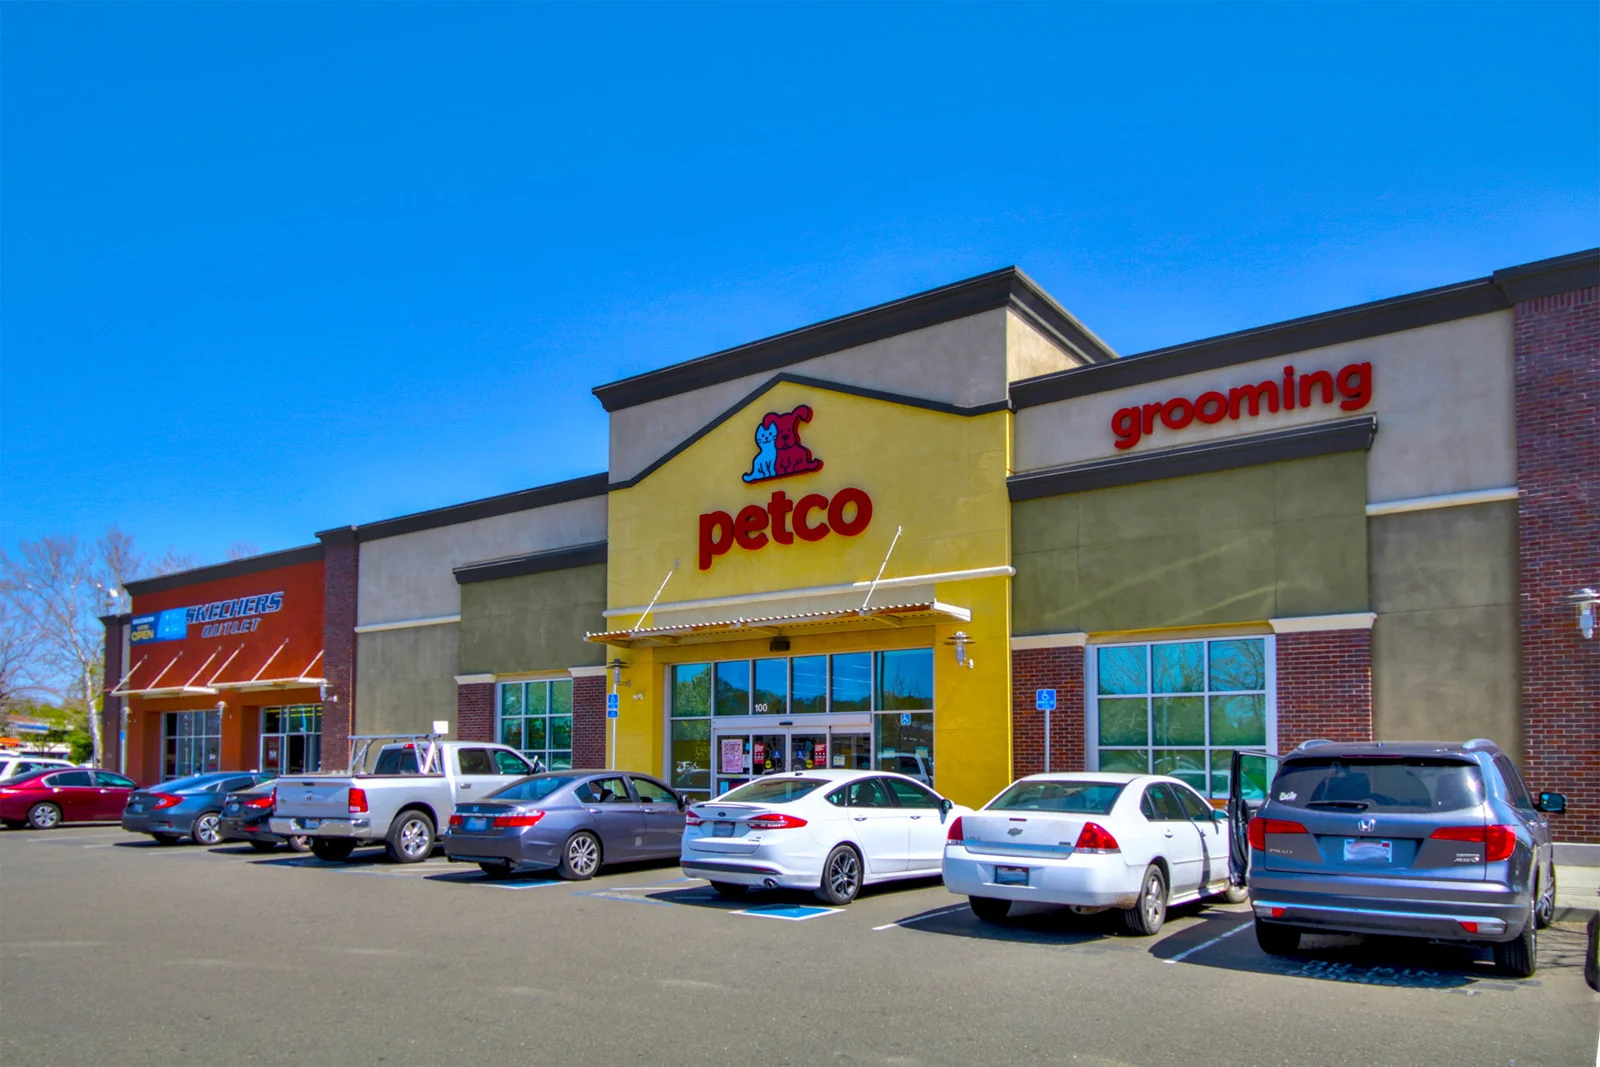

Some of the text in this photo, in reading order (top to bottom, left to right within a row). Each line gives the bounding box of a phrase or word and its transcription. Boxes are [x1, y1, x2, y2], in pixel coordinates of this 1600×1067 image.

[1111, 361, 1373, 450] grooming
[698, 487, 873, 571] petco
[185, 591, 285, 625] SKECHERS
[131, 629, 154, 641] OPEN
[201, 617, 262, 638] OUTLET
[754, 703, 768, 712] 100
